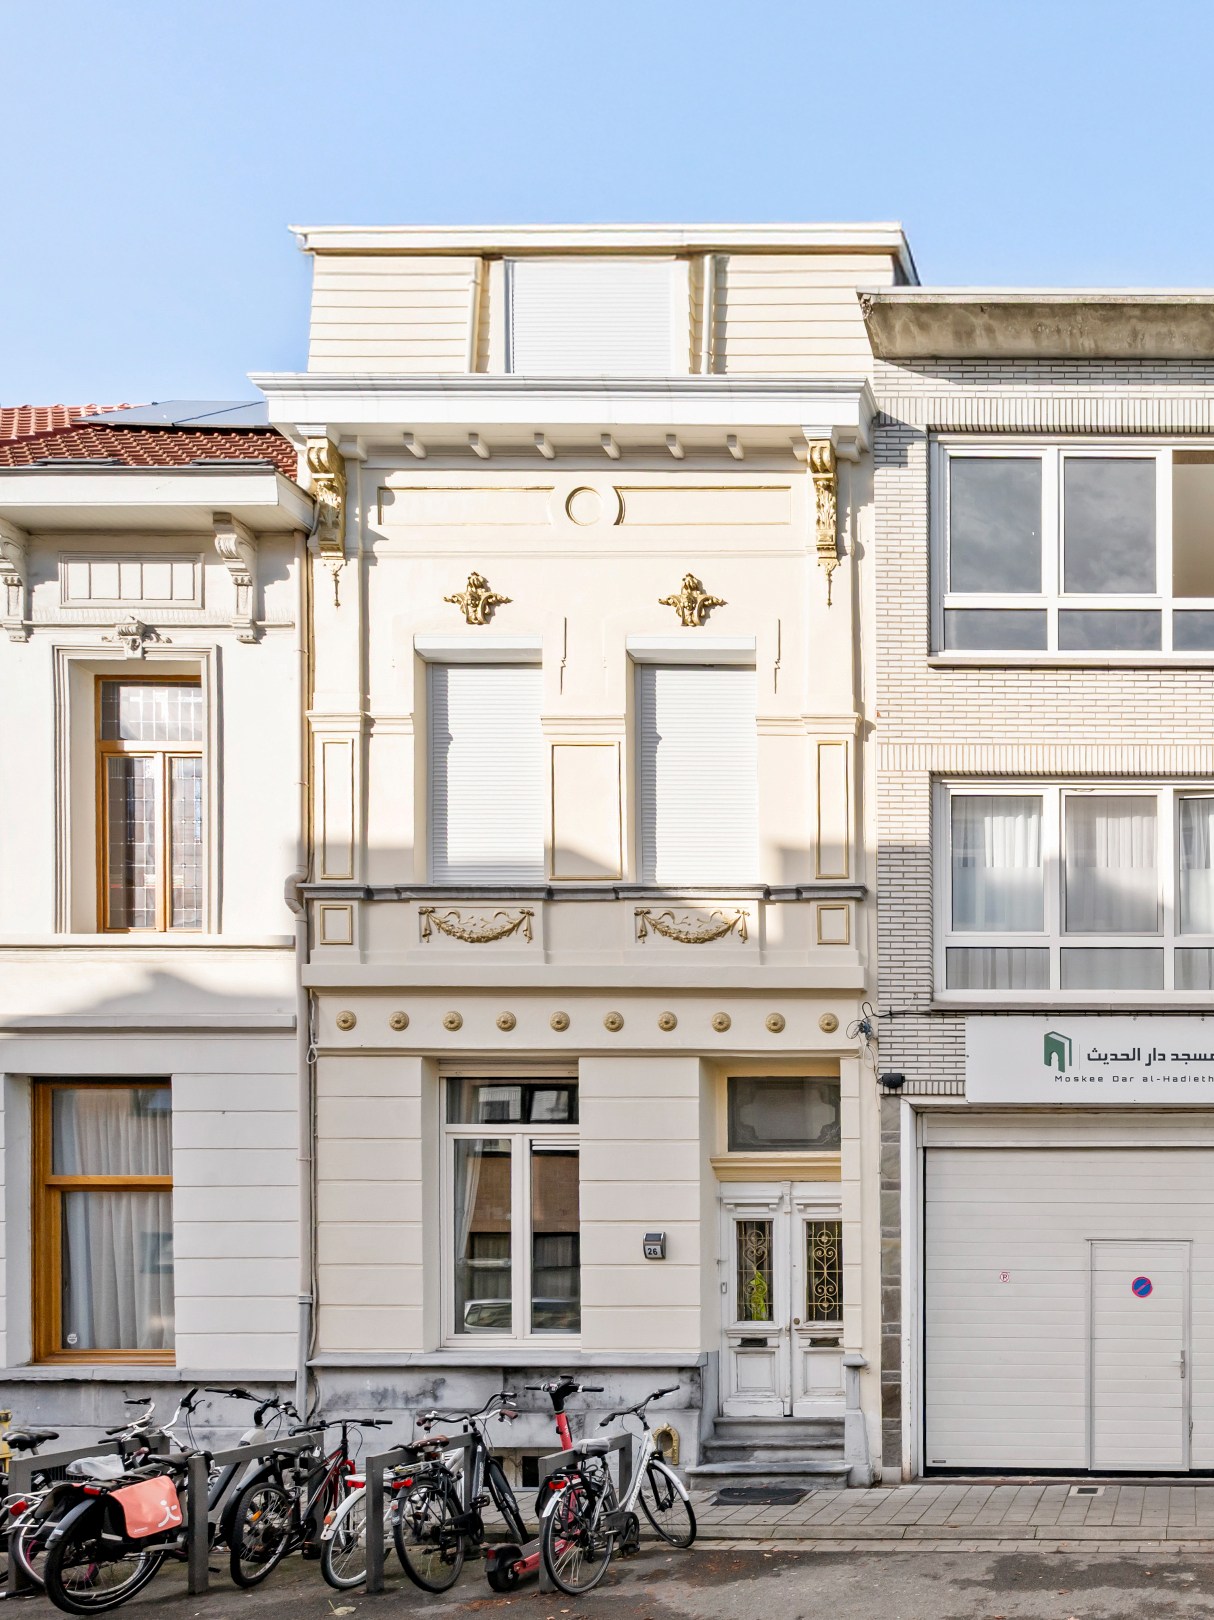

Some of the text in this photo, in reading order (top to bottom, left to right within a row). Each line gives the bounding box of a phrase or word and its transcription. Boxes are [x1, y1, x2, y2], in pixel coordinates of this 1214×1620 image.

[1087, 1047, 1141, 1065] الحديث
[1145, 1047, 1166, 1067] دار
[1054, 1075, 1214, 1083] Moskee Dar al-Hadieth
[647, 1247, 658, 1256] 26
